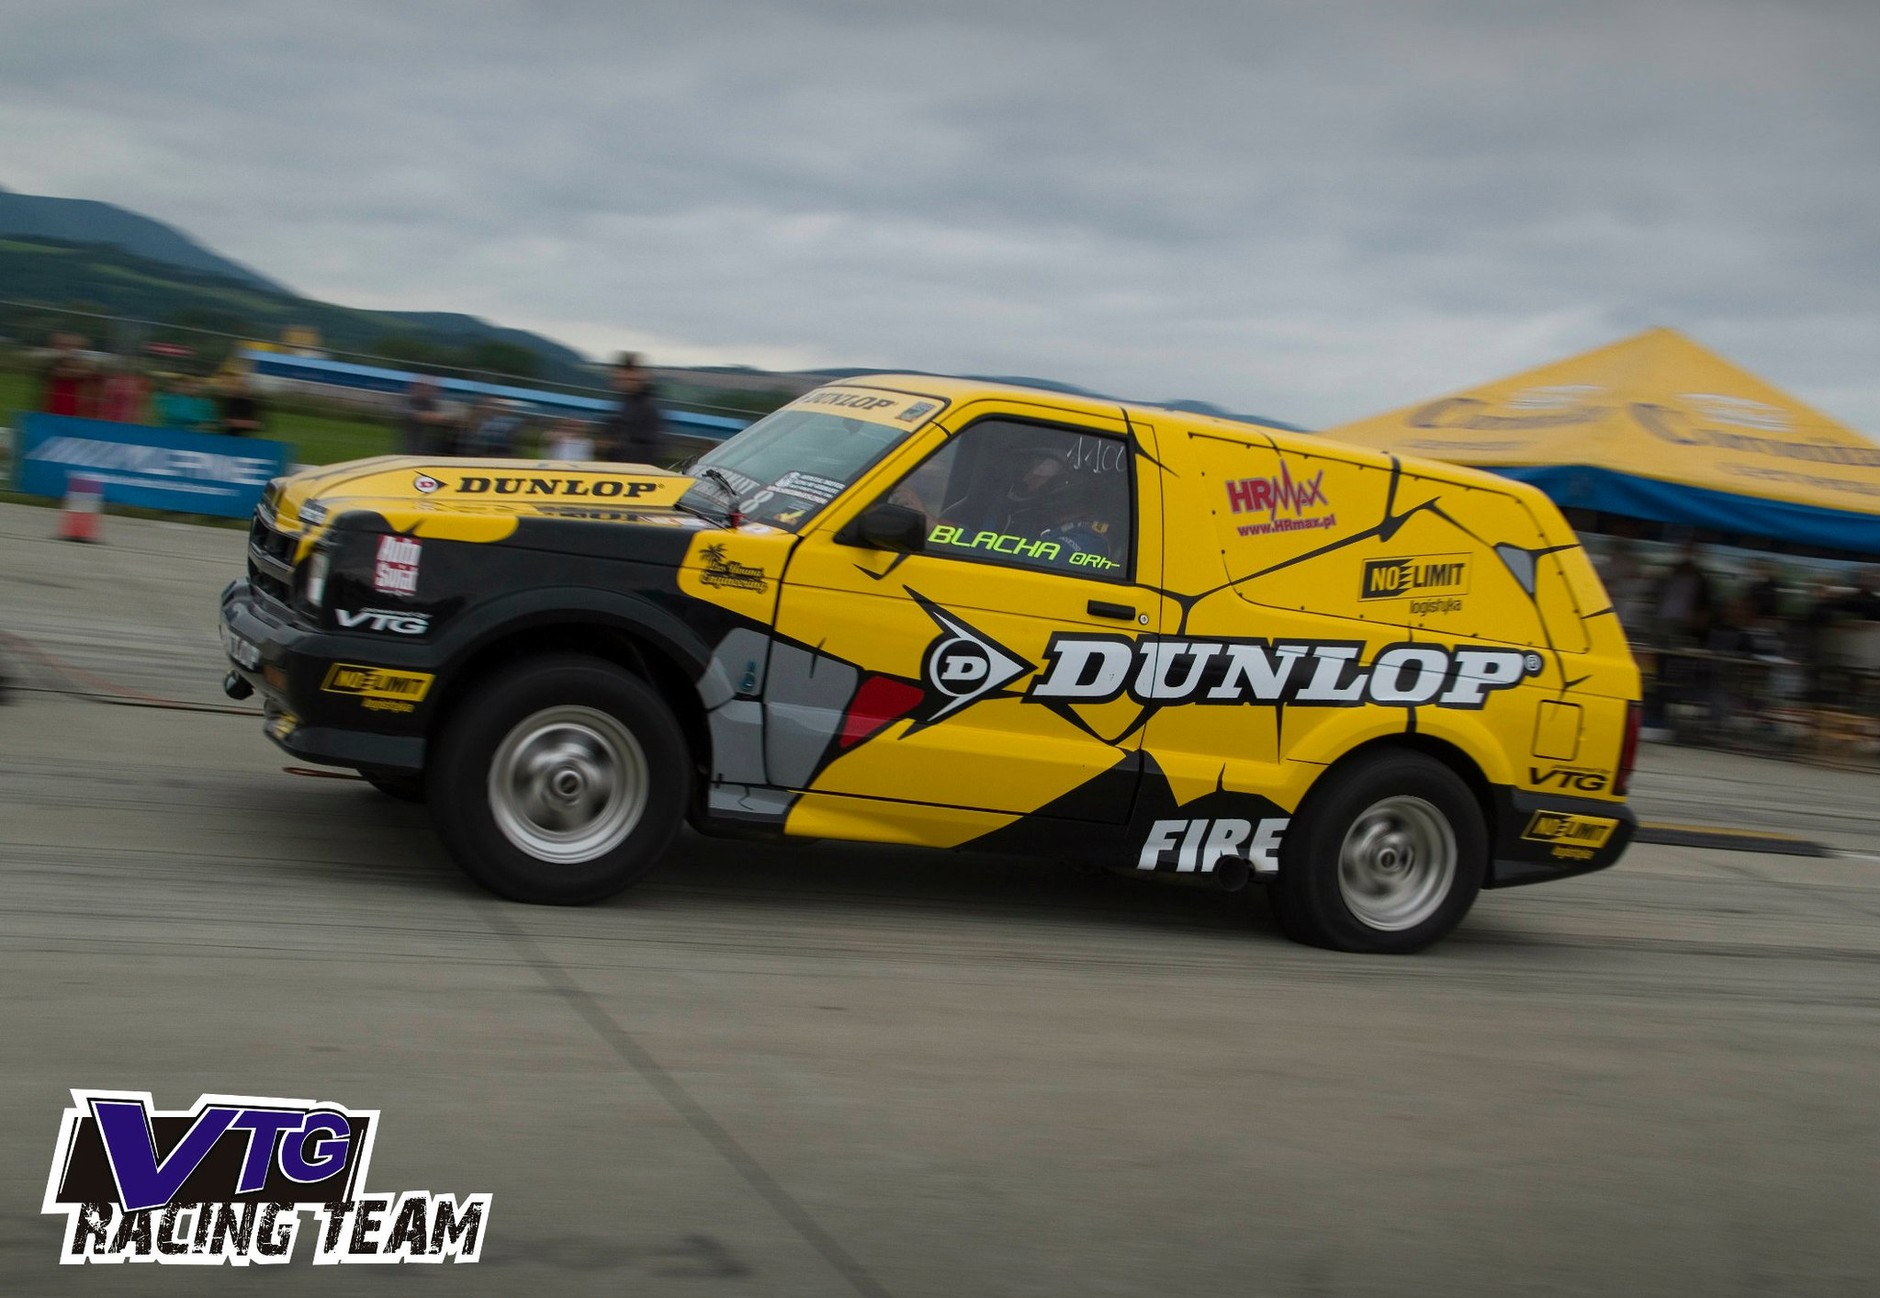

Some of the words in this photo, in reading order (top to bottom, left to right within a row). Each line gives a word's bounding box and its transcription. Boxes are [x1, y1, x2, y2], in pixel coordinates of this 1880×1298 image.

[456, 477, 657, 498] DUNLOP
[1237, 513, 1337, 536] www.HRmax.pl
[927, 524, 1061, 560] BLACHA
[1370, 566, 1400, 592] NO
[1413, 563, 1465, 588] LIMIT
[335, 608, 429, 634] VTG
[1528, 767, 1608, 791] VTG
[1137, 818, 1291, 873] FIRE
